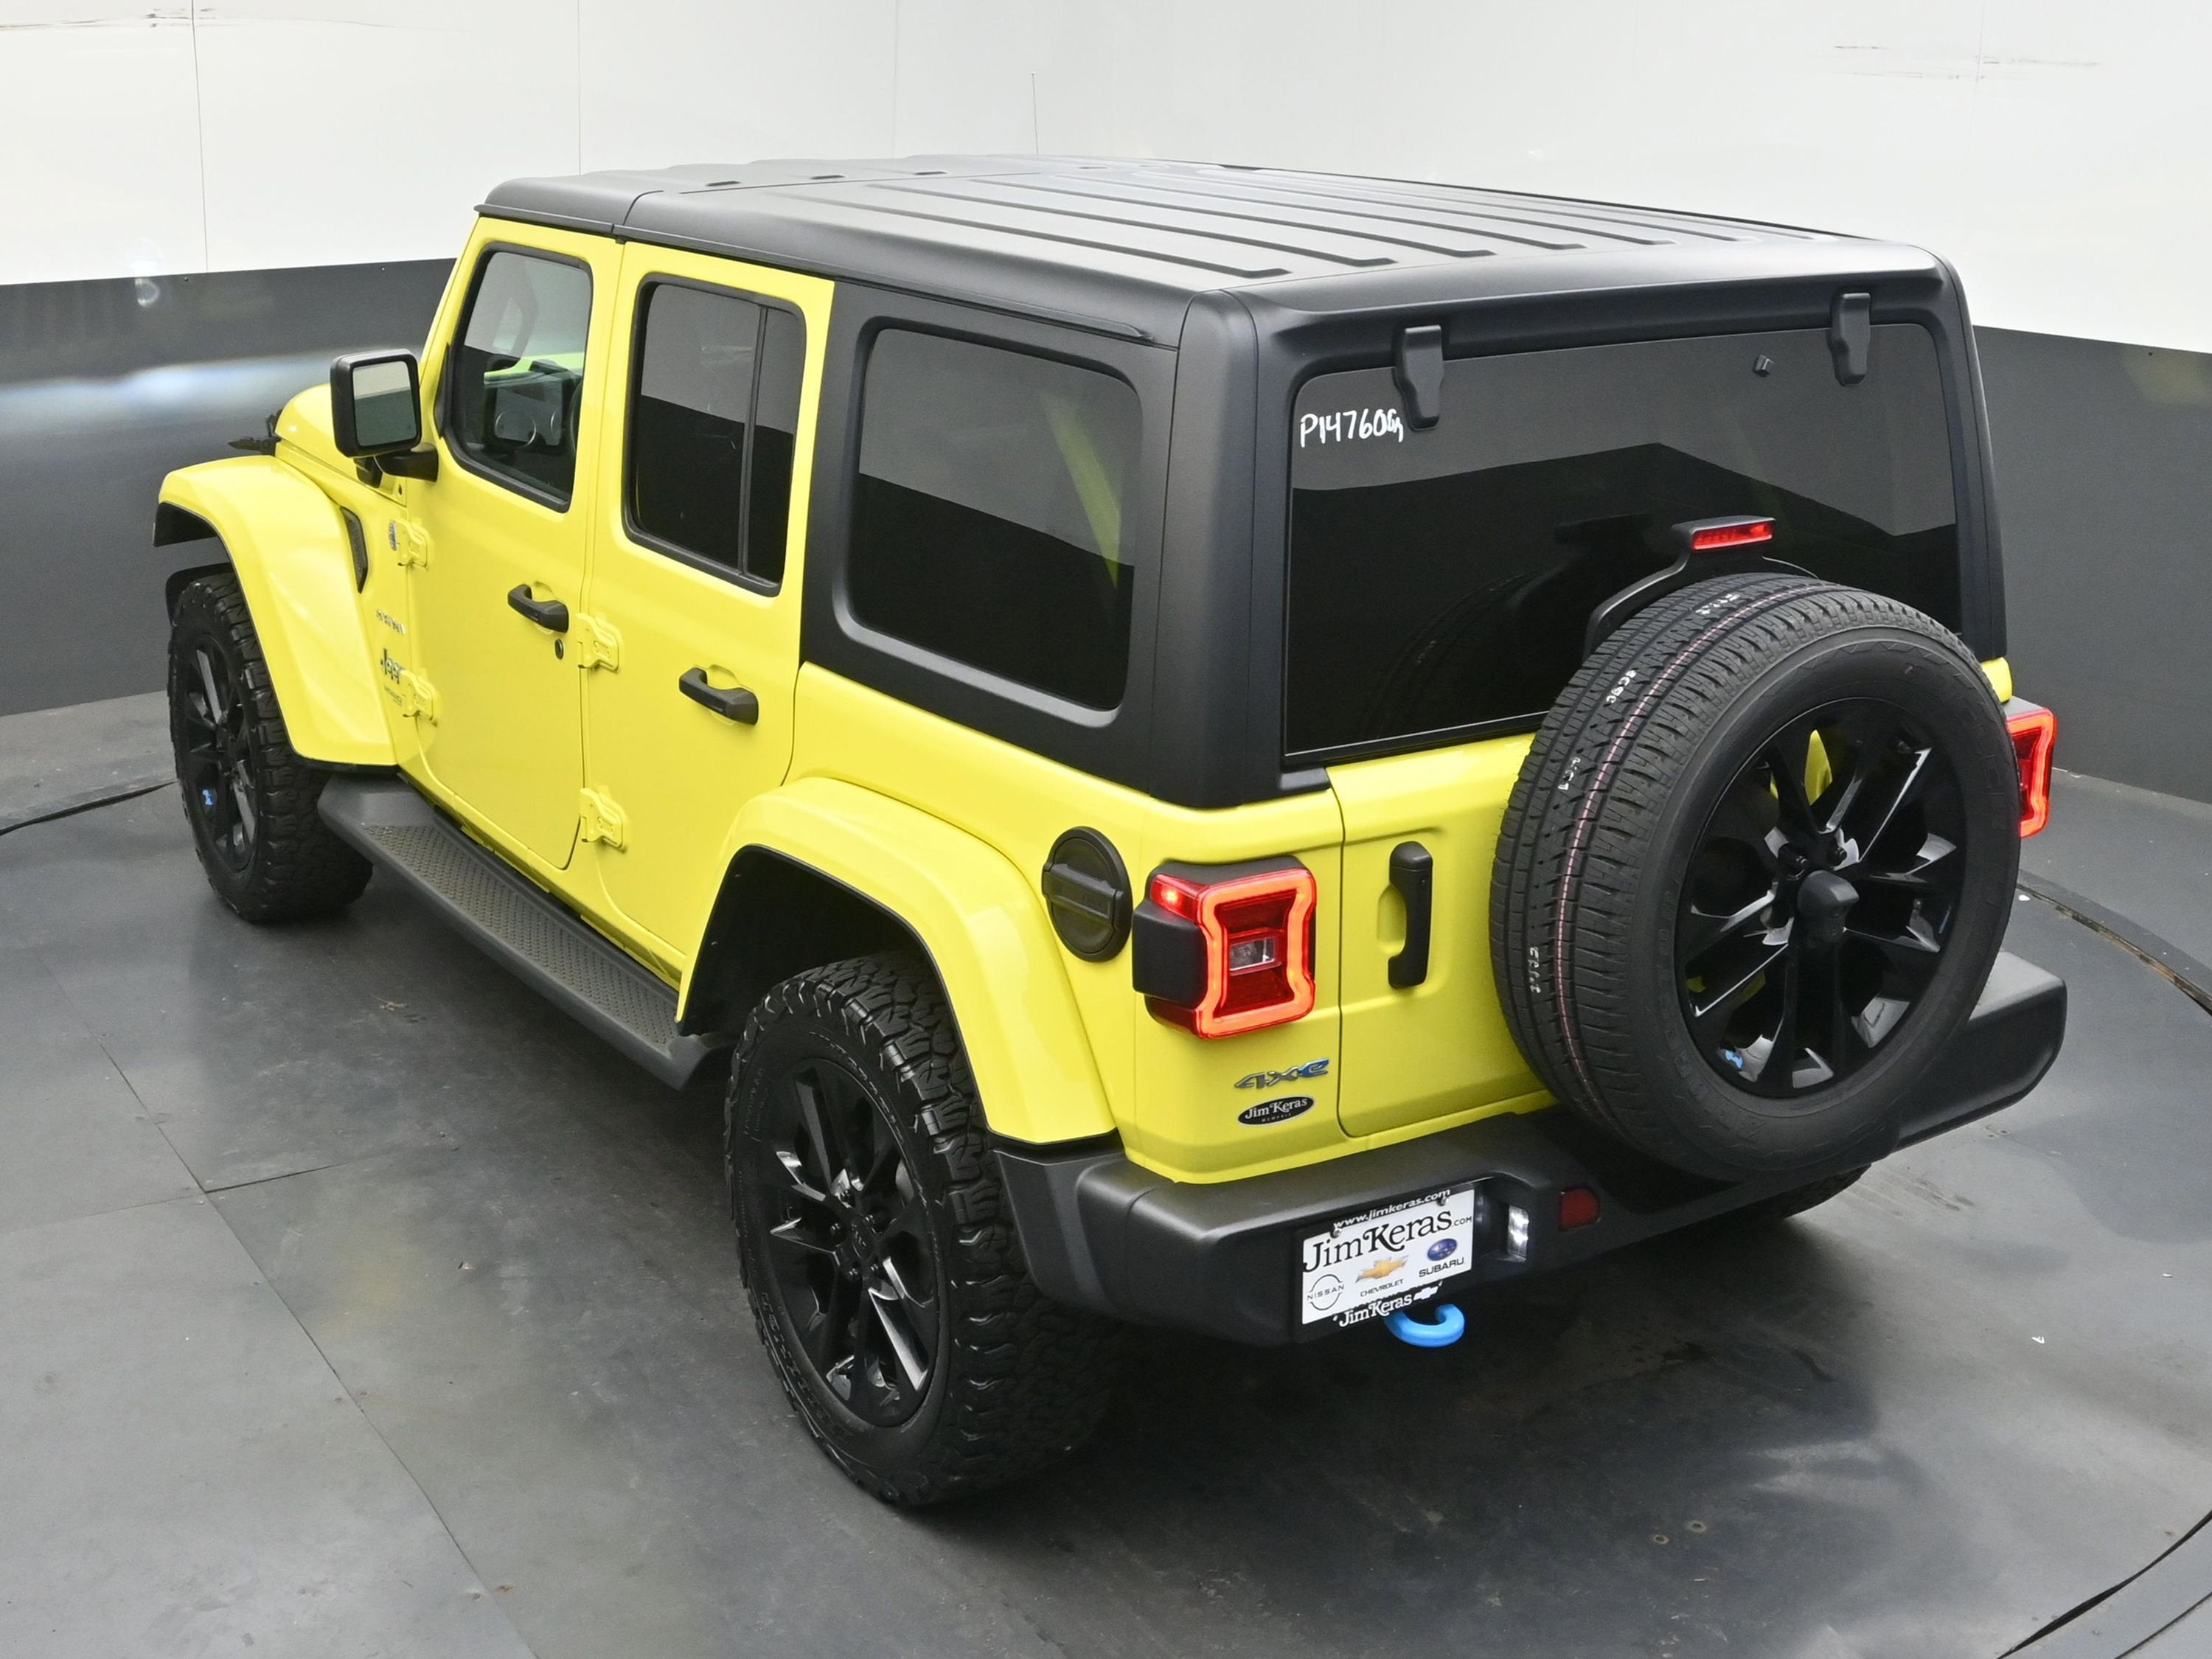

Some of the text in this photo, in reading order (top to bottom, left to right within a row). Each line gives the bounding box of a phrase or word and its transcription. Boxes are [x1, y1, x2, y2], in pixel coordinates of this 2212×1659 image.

[1333, 1189, 1451, 1229] www.jimkeras.com
[1419, 1257, 1464, 1278] SUBARU
[1307, 1284, 1344, 1301] NISSAN
[1360, 1279, 1404, 1297] CHEVROLET
